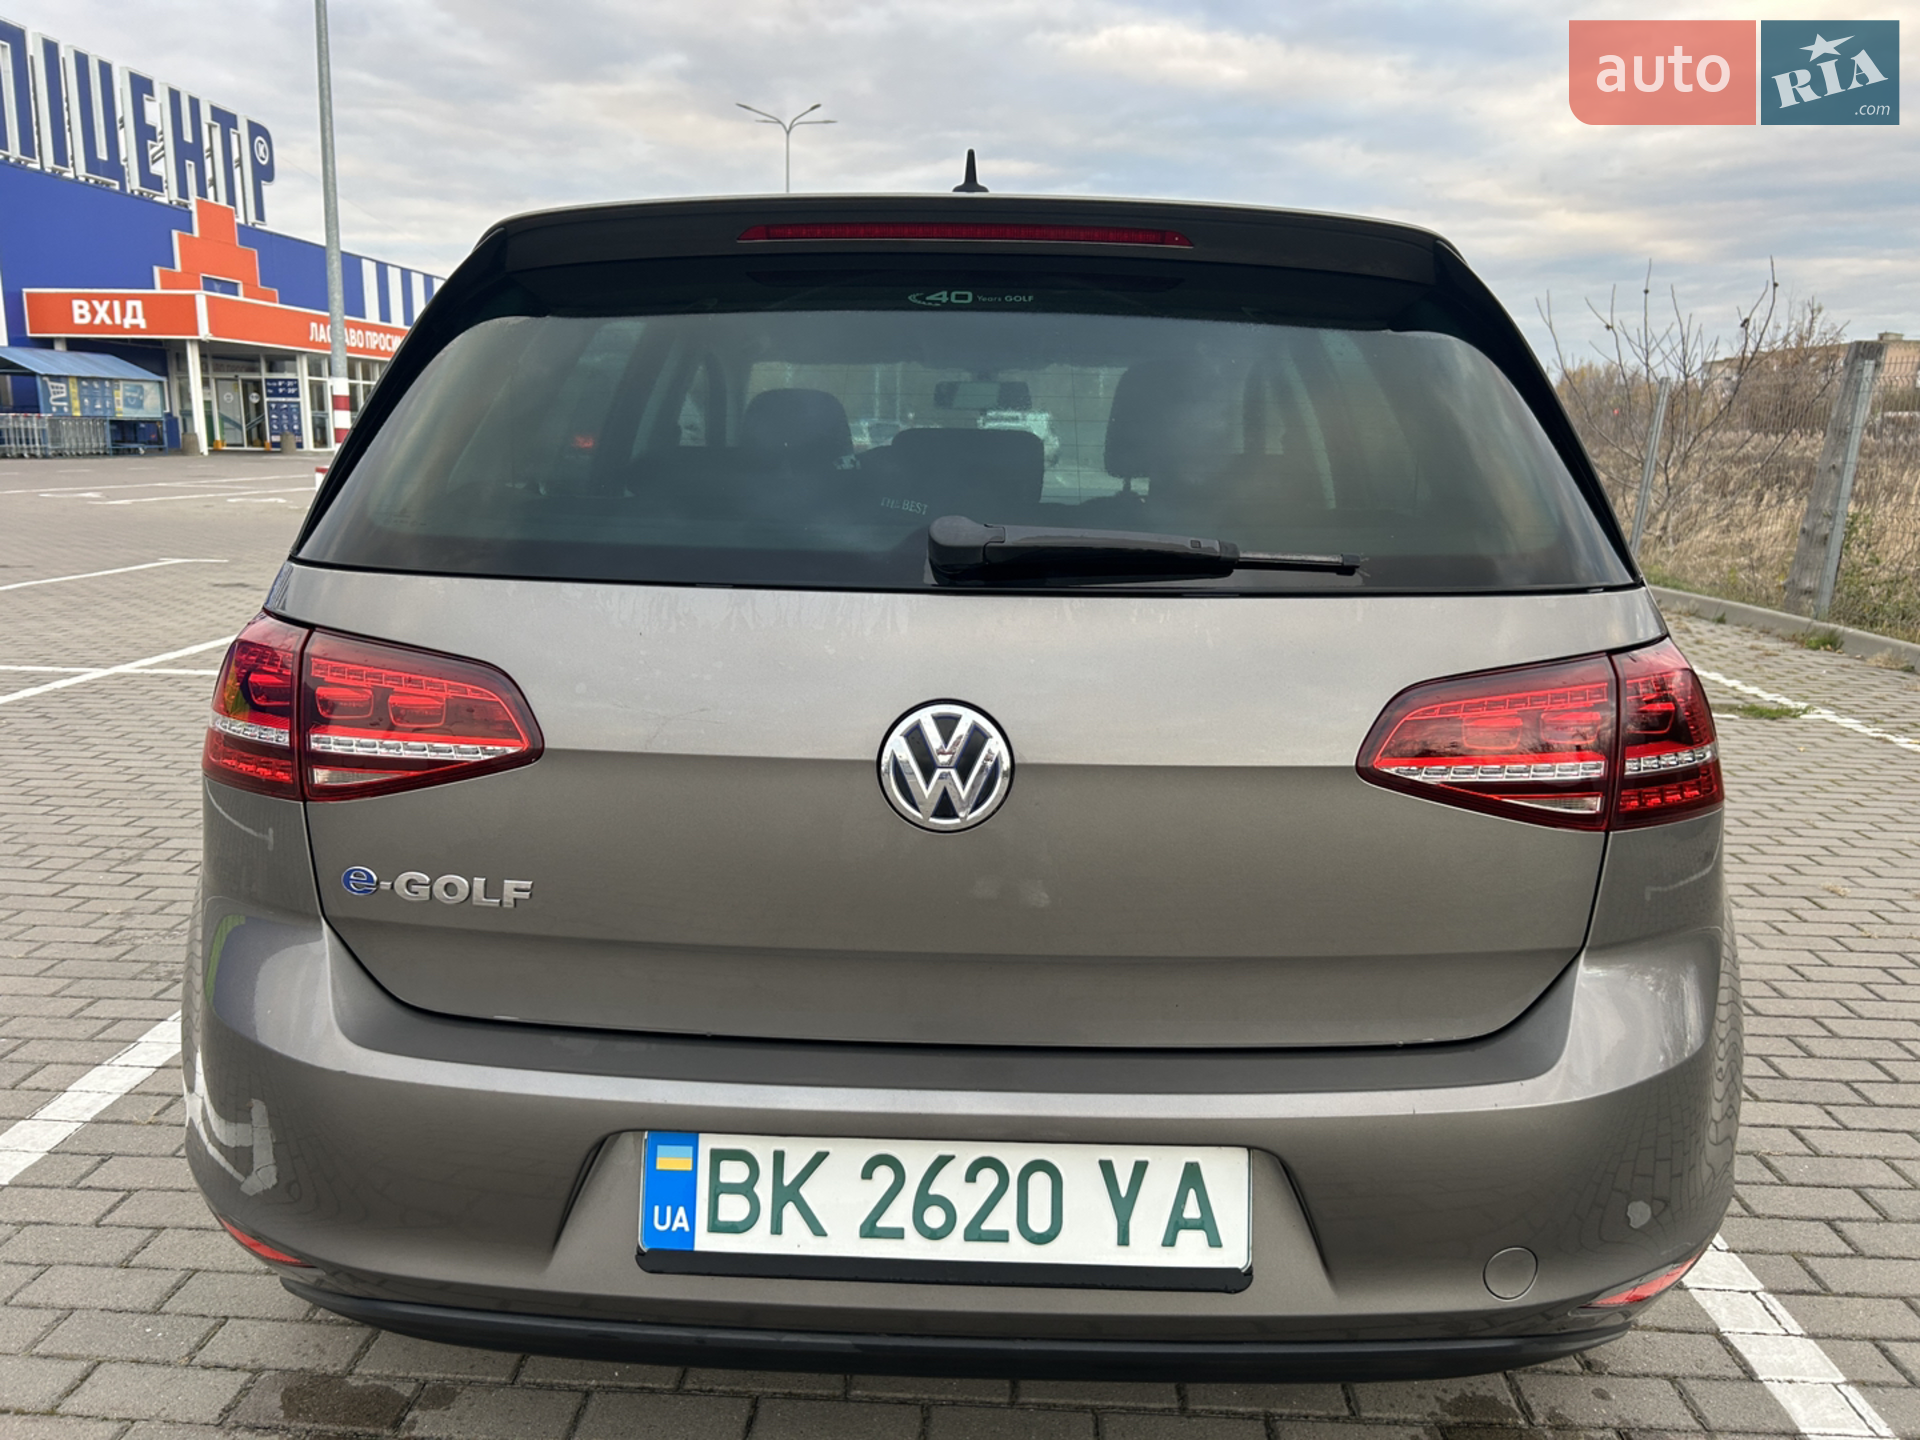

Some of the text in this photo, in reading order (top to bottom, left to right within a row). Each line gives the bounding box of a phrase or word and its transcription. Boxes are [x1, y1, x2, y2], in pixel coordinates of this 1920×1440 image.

[925, 290, 1034, 304] 40 Years GOLF
[72, 299, 147, 329] ВХІД
[309, 321, 405, 352] ЛАСАВО ПРОСИ
[902, 499, 928, 515] BEST
[882, 704, 1012, 831] VW
[341, 865, 534, 908] e-GOLF
[707, 1147, 1223, 1248] BK 2620 YA
[653, 1206, 690, 1233] UA
